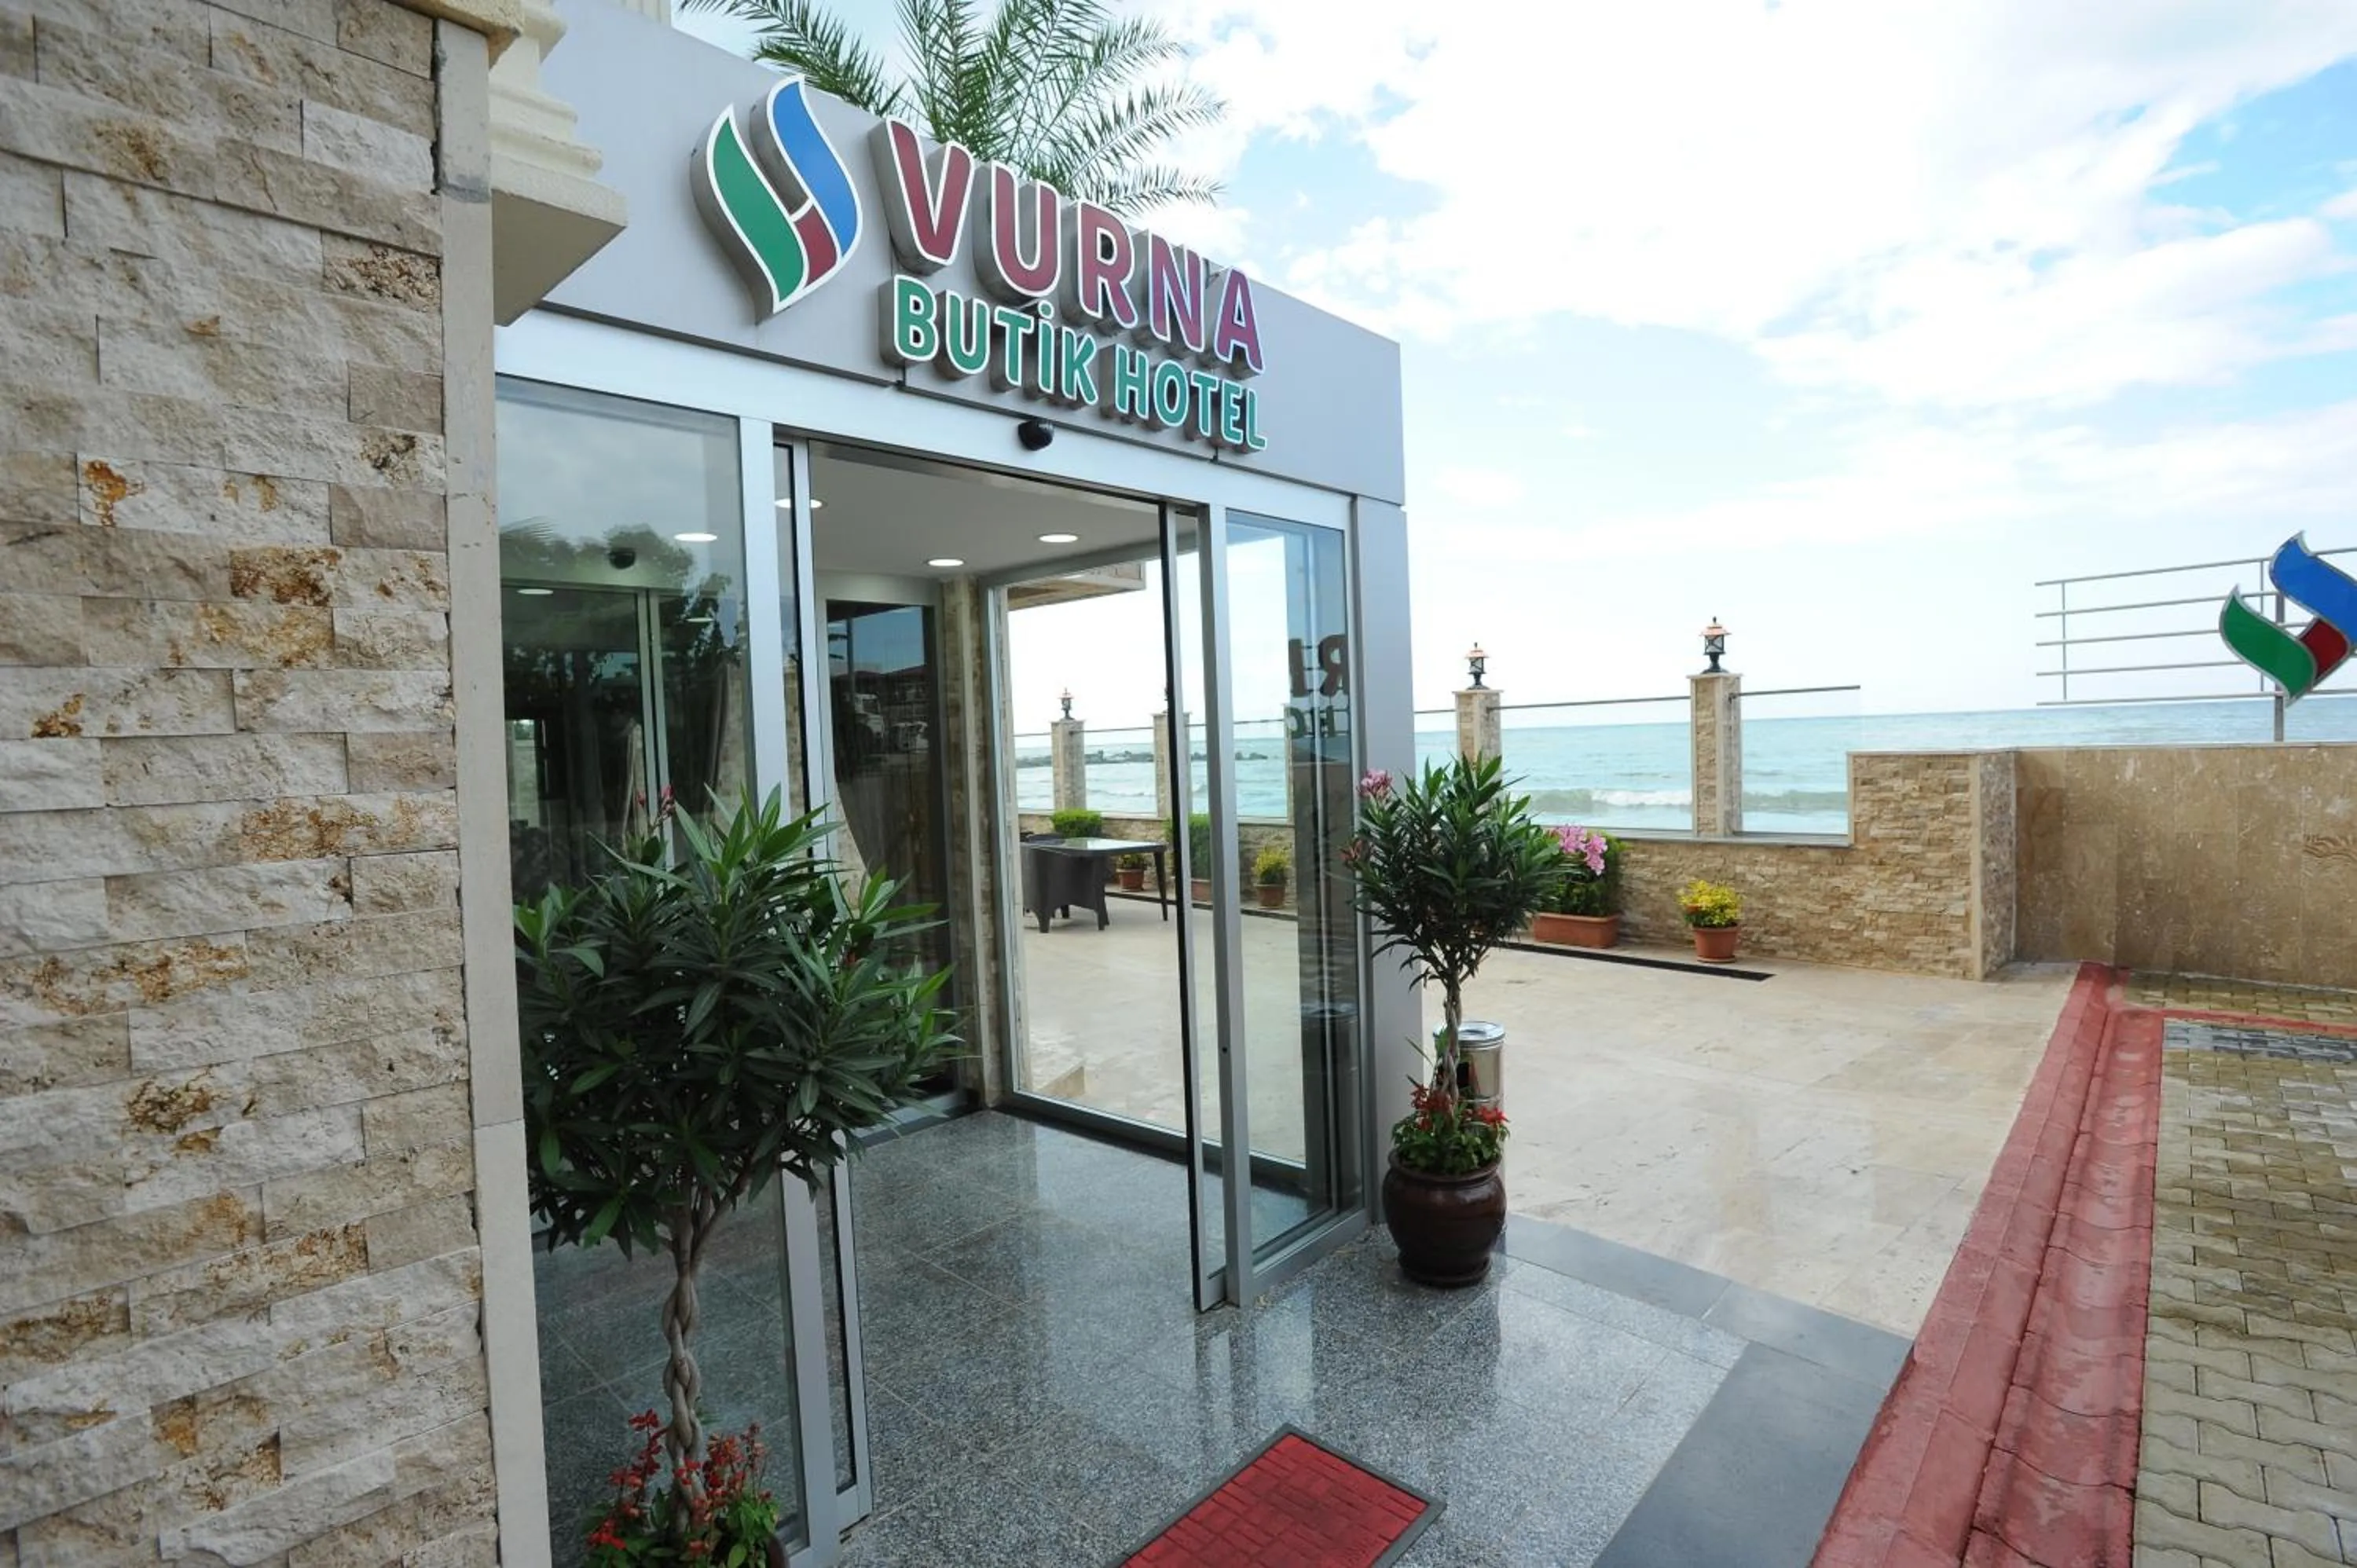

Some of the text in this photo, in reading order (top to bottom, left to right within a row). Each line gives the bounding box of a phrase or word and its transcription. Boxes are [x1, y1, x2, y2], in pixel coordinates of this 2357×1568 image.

[886, 116, 1265, 372] VURNA
[893, 275, 1266, 450] BUTİK HOTEL
